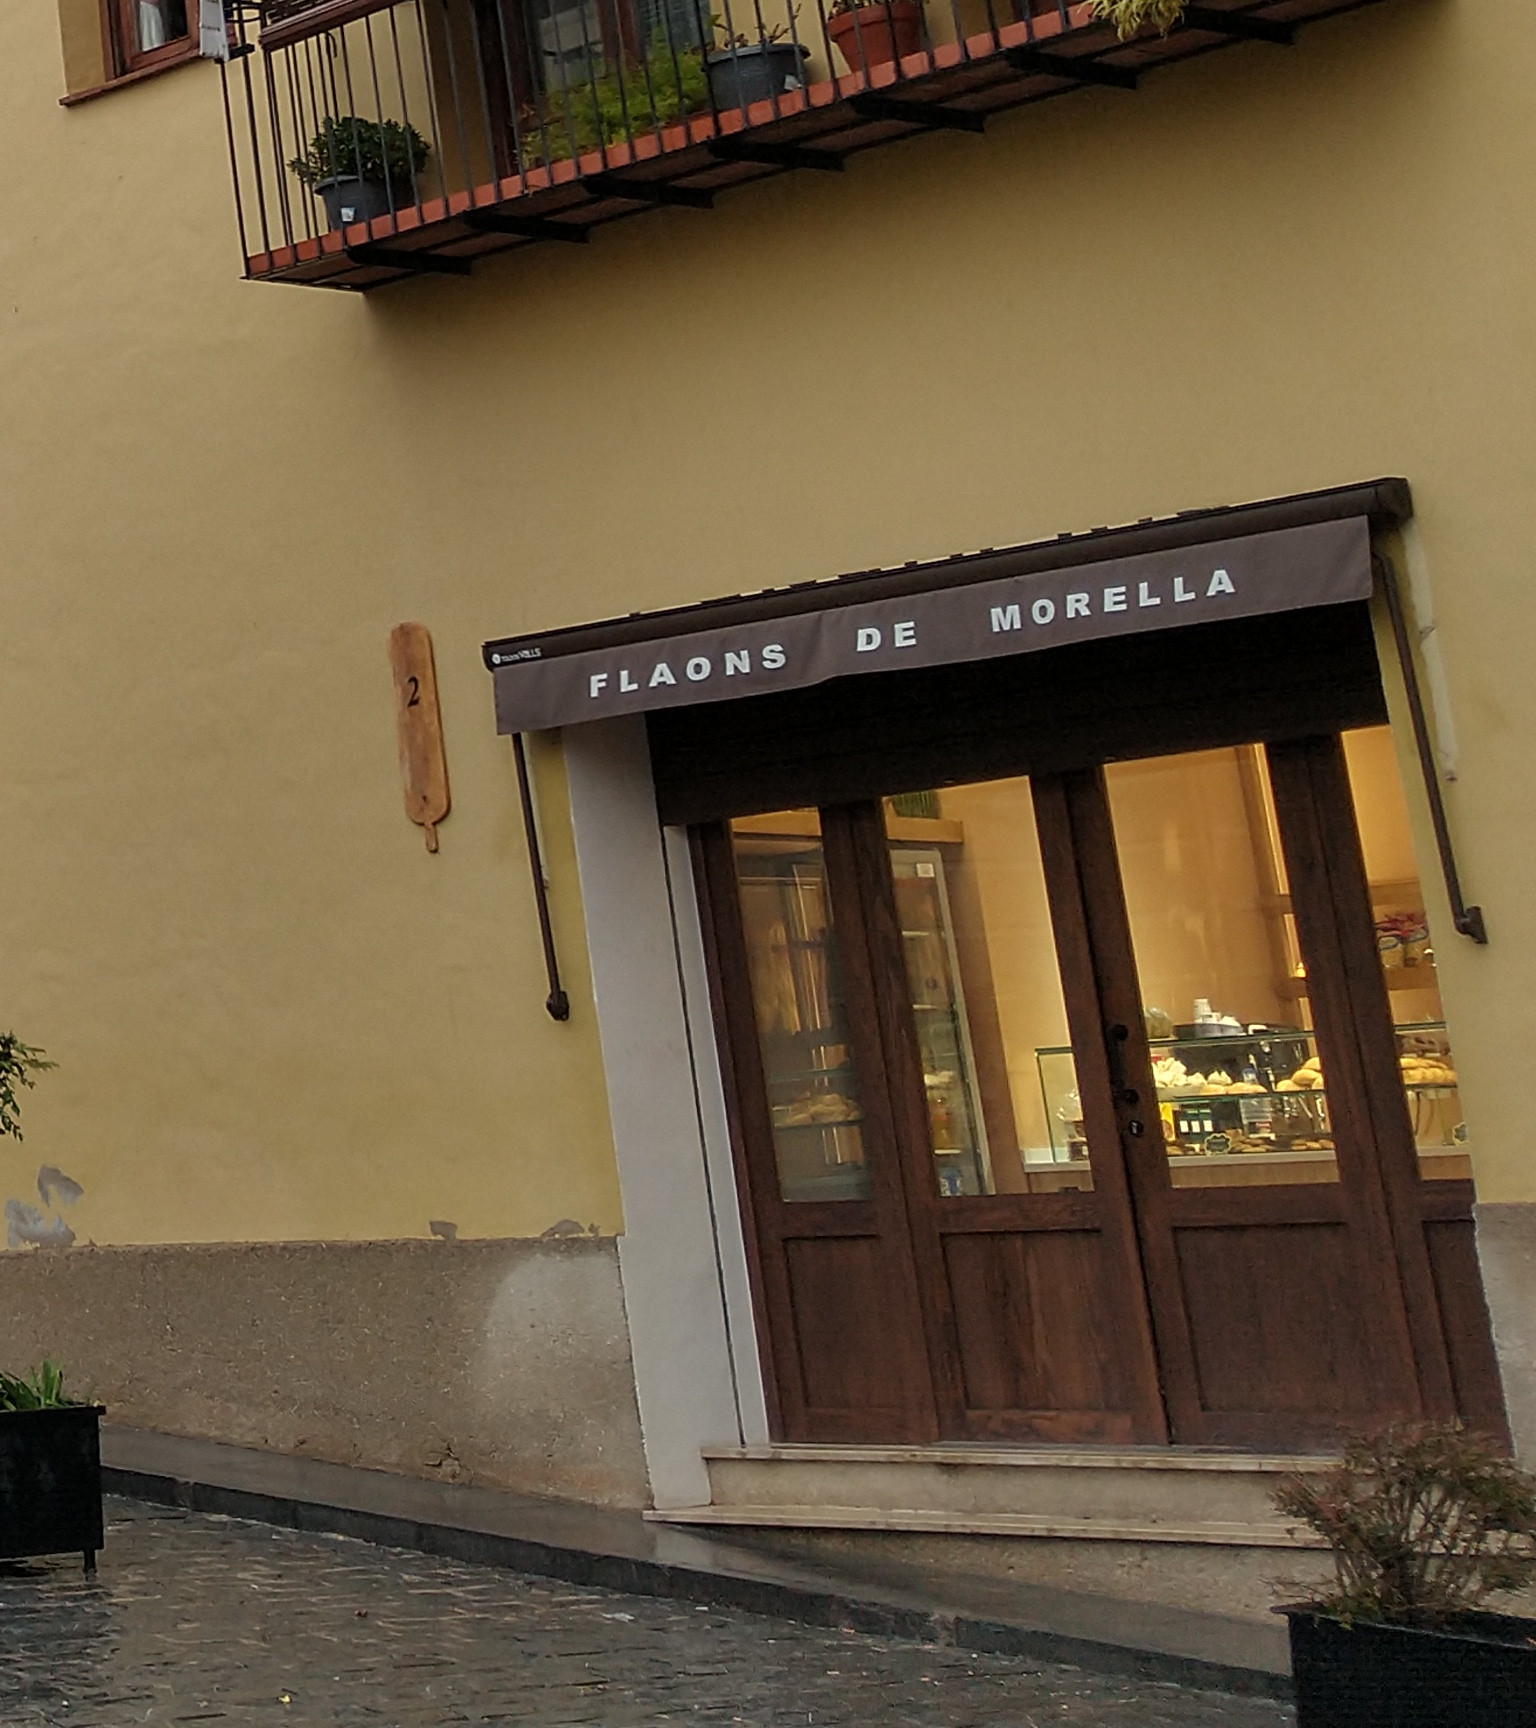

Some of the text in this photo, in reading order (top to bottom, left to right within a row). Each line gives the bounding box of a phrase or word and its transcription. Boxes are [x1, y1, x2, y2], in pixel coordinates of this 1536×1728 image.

[589, 568, 1236, 699] FLAONS DE MORELLA
[407, 676, 420, 708] 2
